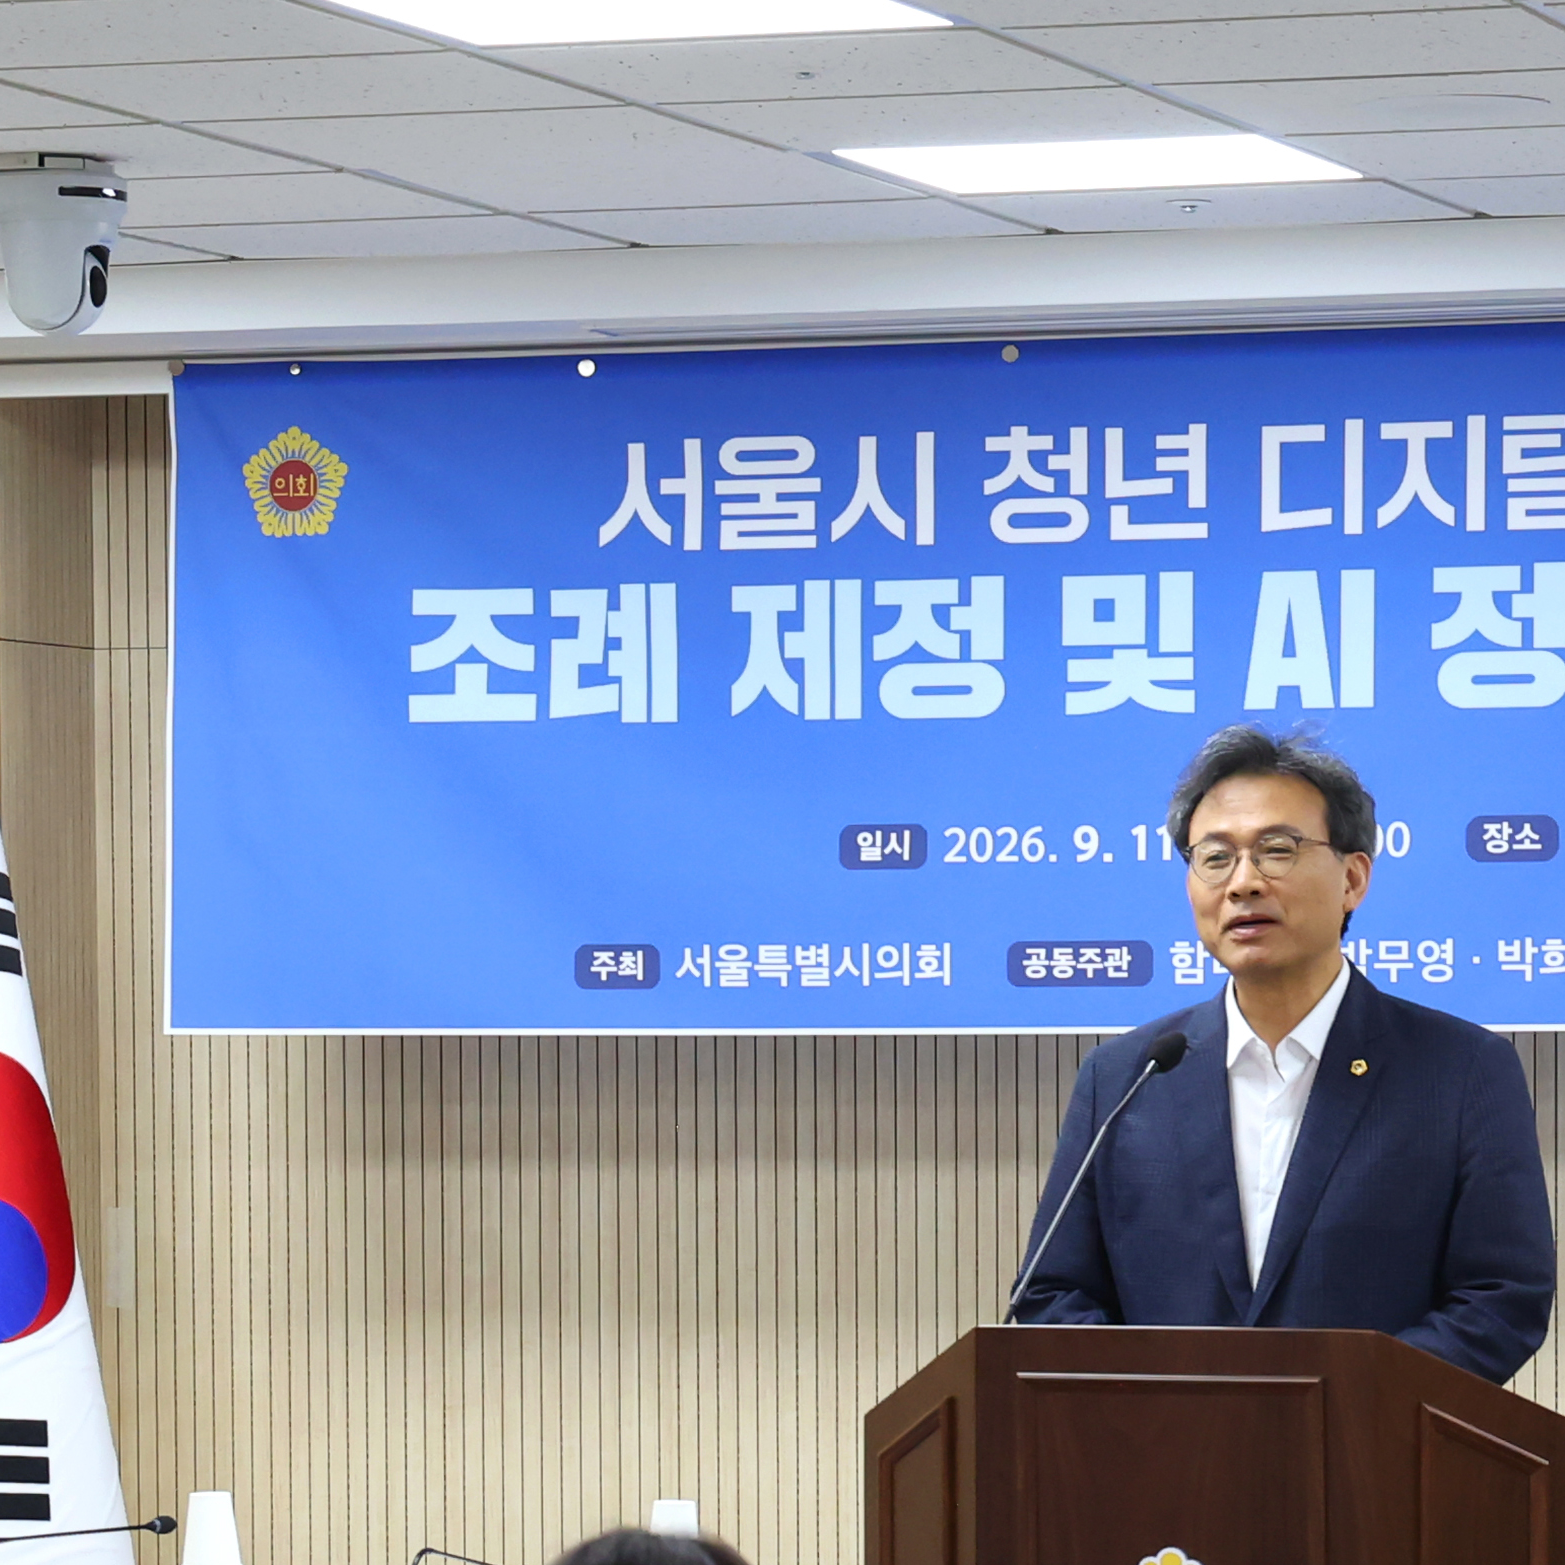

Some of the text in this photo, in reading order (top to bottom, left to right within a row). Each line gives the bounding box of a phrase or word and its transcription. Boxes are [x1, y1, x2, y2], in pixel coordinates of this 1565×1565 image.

[272, 472, 315, 498] 의회
[599, 431, 935, 551] 서울시
[983, 423, 1208, 544] 청년
[408, 583, 678, 723] 조례
[731, 575, 1005, 720] 제정
[1062, 571, 1195, 715] 및
[1243, 569, 1375, 710] AI
[856, 829, 910, 862] 일시
[943, 825, 1058, 863] 2026.
[1073, 824, 1114, 863] 9.
[1482, 821, 1542, 854] 장소
[590, 949, 644, 982] 주최
[675, 942, 951, 988] 서울특별시의회
[1021, 945, 1133, 980] 공동주관
